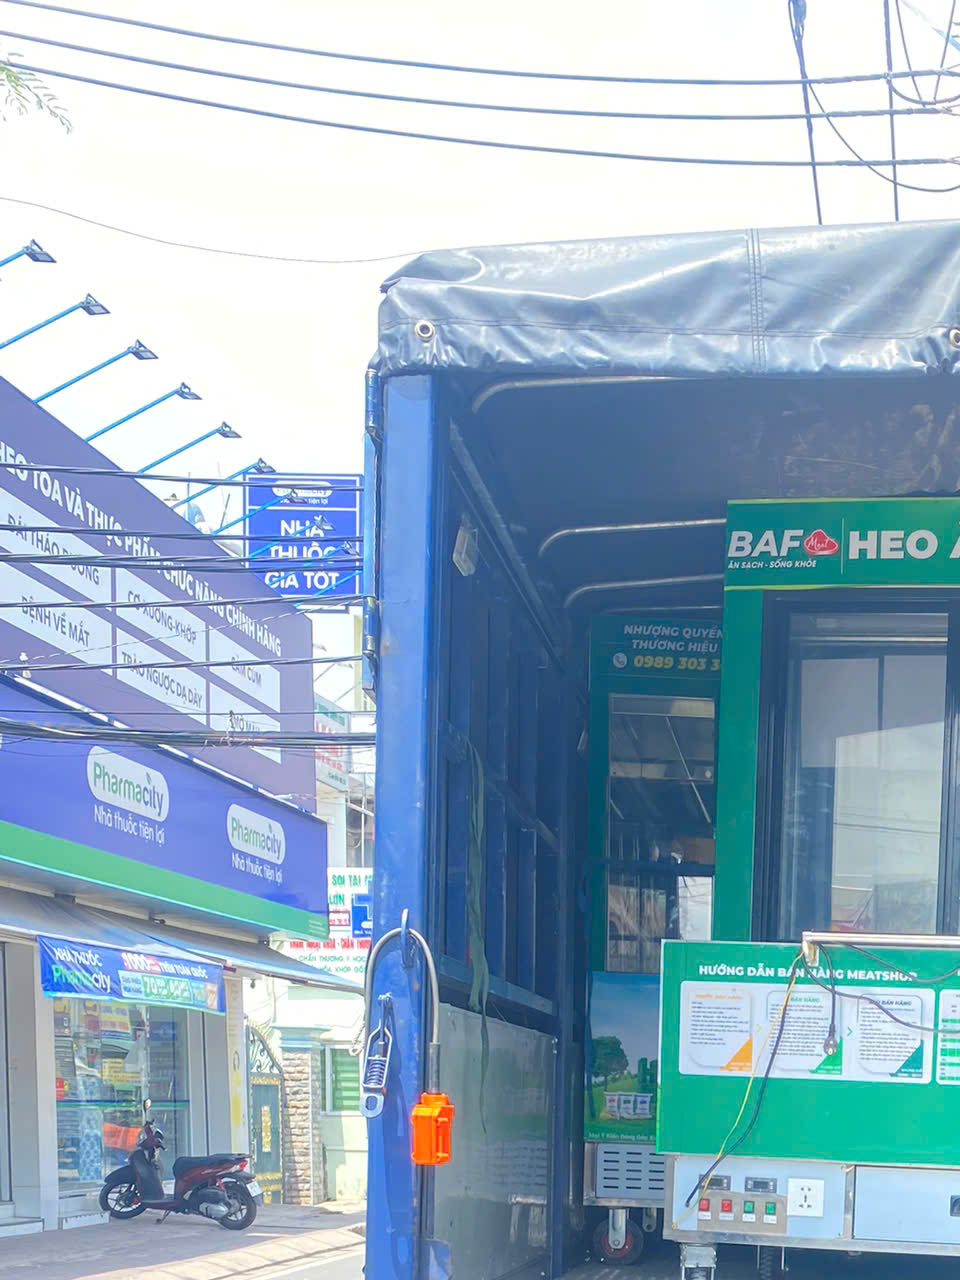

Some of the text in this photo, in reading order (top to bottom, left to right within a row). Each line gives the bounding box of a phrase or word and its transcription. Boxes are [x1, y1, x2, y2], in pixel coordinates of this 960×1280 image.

[64, 486, 84, 522] VÀ
[727, 529, 804, 558] BAF
[848, 529, 939, 560] HEO
[769, 558, 793, 568] SỐNG
[623, 624, 680, 638] NHƯỢNG
[631, 639, 719, 654] THƯƠNG HIỆU
[633, 655, 674, 669] 0989
[677, 656, 707, 671] 303
[93, 761, 164, 817] Pharmacity
[94, 804, 165, 847] Nhà thuốc tiện lợi
[231, 817, 282, 860] Pharmacity
[231, 852, 245, 871] Nhà
[245, 857, 263, 878] thuốc
[698, 963, 745, 977] HƯỚNG
[746, 962, 775, 978] DẪN
